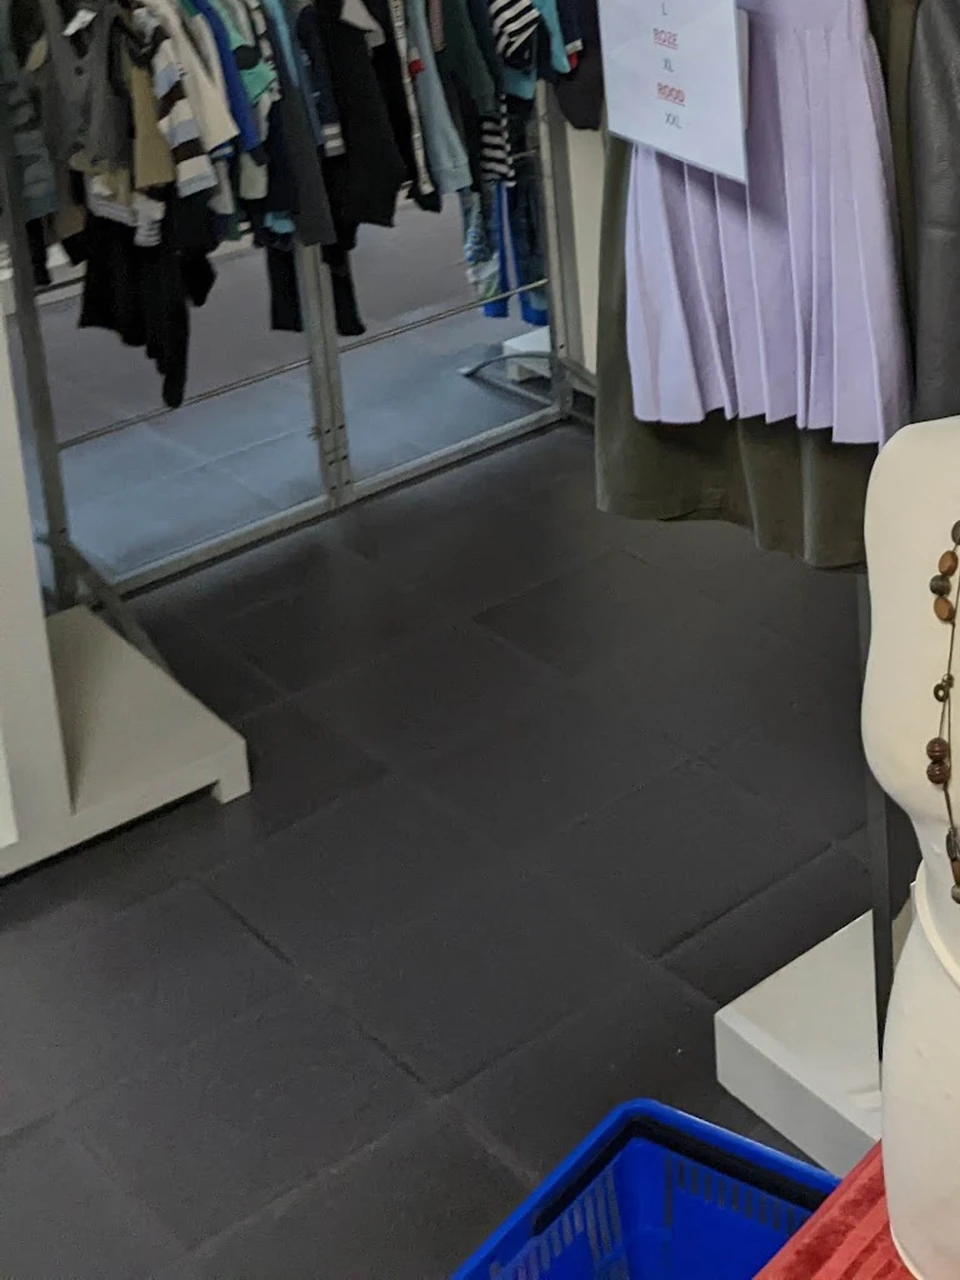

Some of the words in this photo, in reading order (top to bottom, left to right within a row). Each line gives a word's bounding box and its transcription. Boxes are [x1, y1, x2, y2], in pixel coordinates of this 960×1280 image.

[661, 1, 668, 16] L
[653, 27, 679, 47] ROZE
[656, 82, 686, 103] ROOD
[664, 112, 682, 130] XXL
